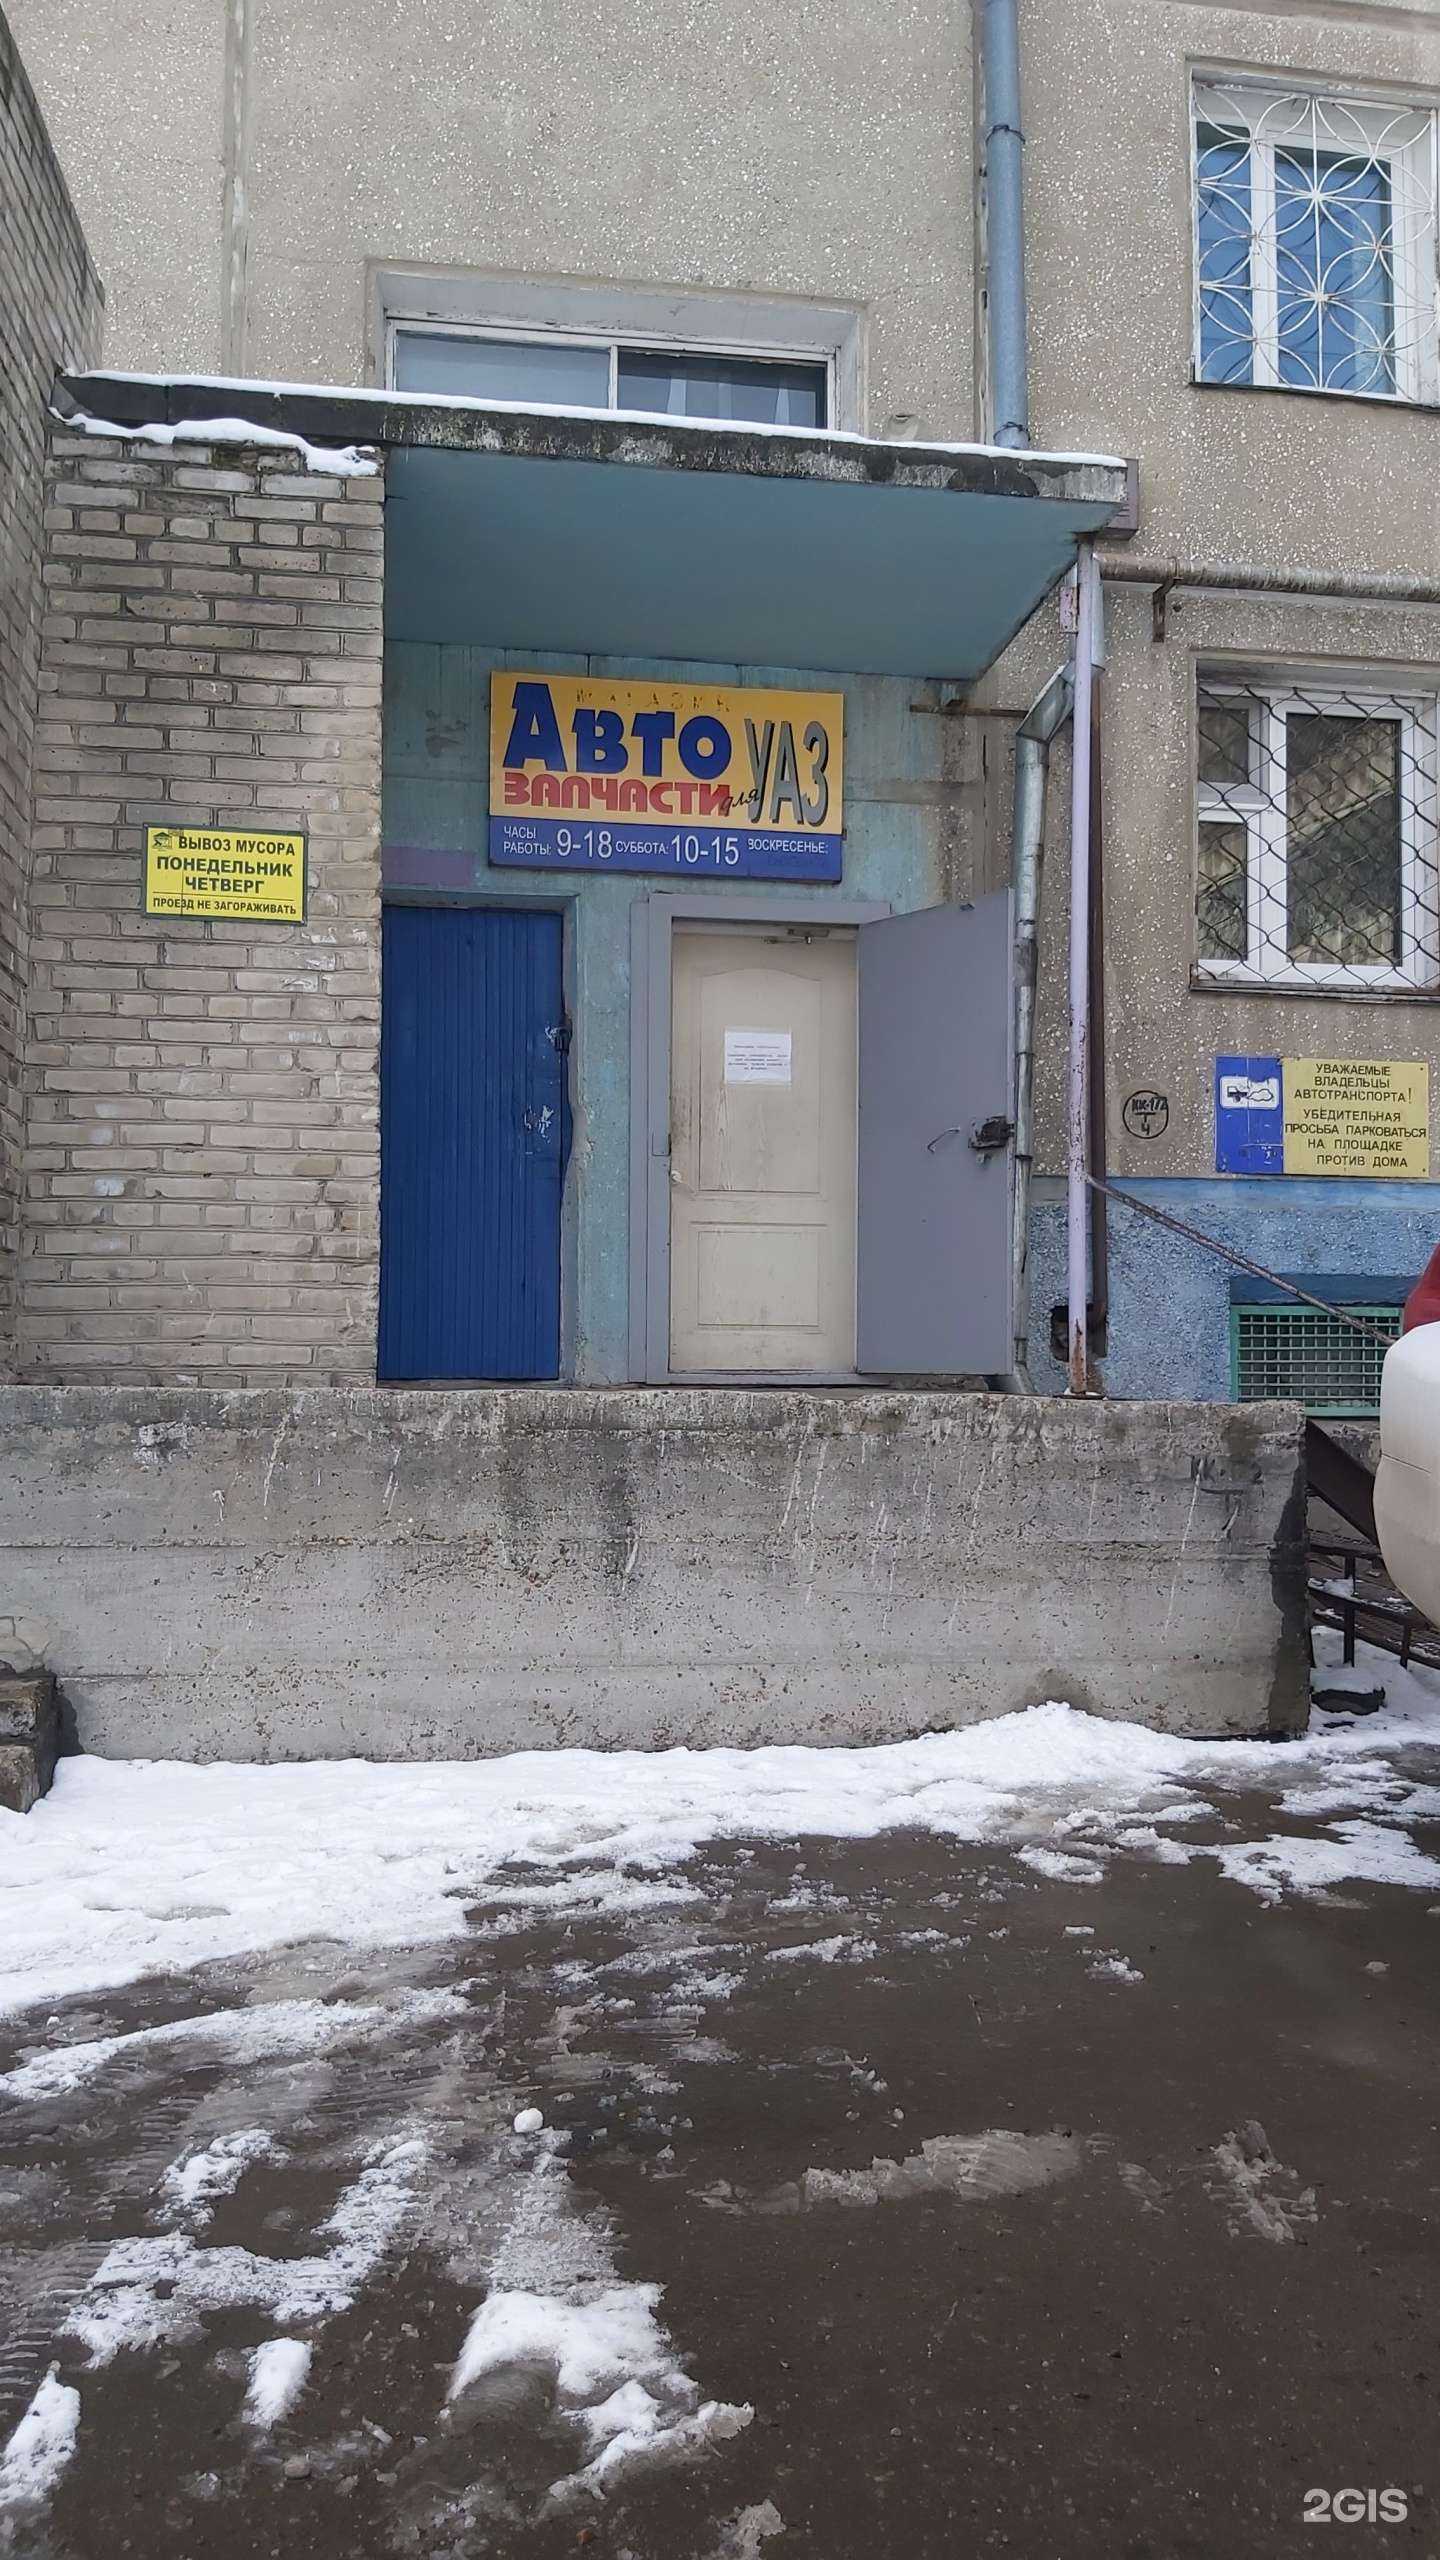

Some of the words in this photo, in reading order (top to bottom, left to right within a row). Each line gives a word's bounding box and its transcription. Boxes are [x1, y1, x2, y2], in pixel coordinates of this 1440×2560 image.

[504, 772, 731, 817] ЗАПЧАСТИ
[744, 718, 829, 827] УАЗ
[503, 825, 537, 839] ЧАСЫ
[178, 836, 231, 852] ВЫВОЗ
[236, 839, 296, 856] МУСОРА
[503, 841, 551, 856] РАБОТЫ:
[556, 829, 612, 859] 9-18
[615, 840, 669, 855] СУББОТА:
[671, 834, 740, 866] 10-15
[157, 856, 293, 877] ПОНЕДЕЛЬНИК
[185, 876, 265, 894] ЧЕТВЕРГ
[153, 897, 195, 911] ПРОЕЗД
[198, 900, 210, 910] НЕ
[214, 901, 297, 915] ЗАГОРАЖИВАТЬ
[1316, 1063, 1391, 1076] УВАЖАЕМЫЕ
[1314, 1076, 1390, 1089] ВЛАДЕЛЬЦЫ
[1303, 1109, 1401, 1122] УБЕДИТЕЛЬНАЯ
[1285, 1123, 1340, 1135] ПРОСЬБА
[1346, 1125, 1427, 1138] ПАРКОВАТЬСЯ
[1307, 1139, 1325, 1149] НА
[1334, 1139, 1403, 1152] ПЛОЩАДКЕ
[1316, 1155, 1365, 1166] ПРОТИВ
[1373, 1156, 1408, 1168] ДОМА
